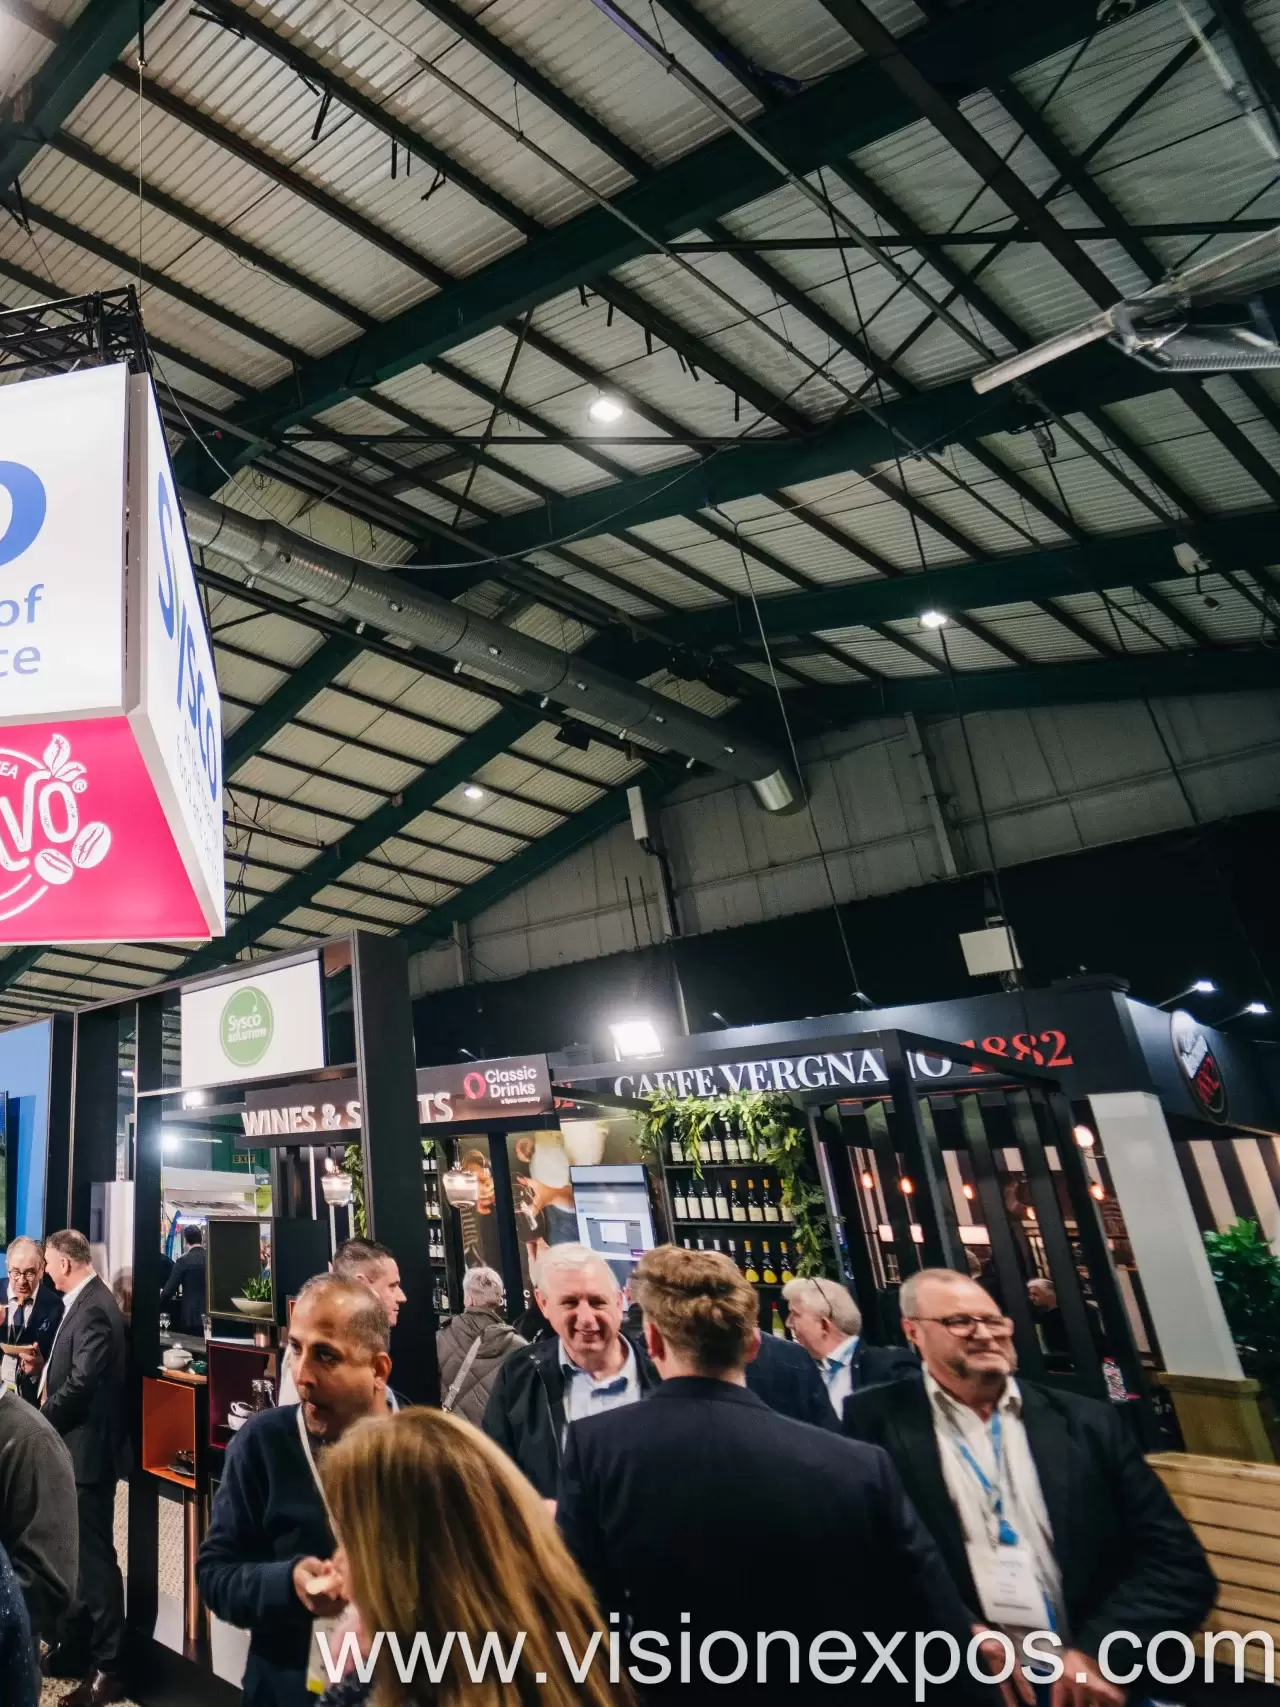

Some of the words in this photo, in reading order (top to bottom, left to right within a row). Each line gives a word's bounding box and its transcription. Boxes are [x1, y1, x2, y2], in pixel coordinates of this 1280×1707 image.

[228, 1014, 262, 1035] Sysco
[485, 1066, 537, 1083] Classic
[718, 1048, 953, 1096] VERGNAO
[489, 1081, 536, 1098] Drinks
[241, 1105, 316, 1136] WINES
[321, 1104, 341, 1131] &
